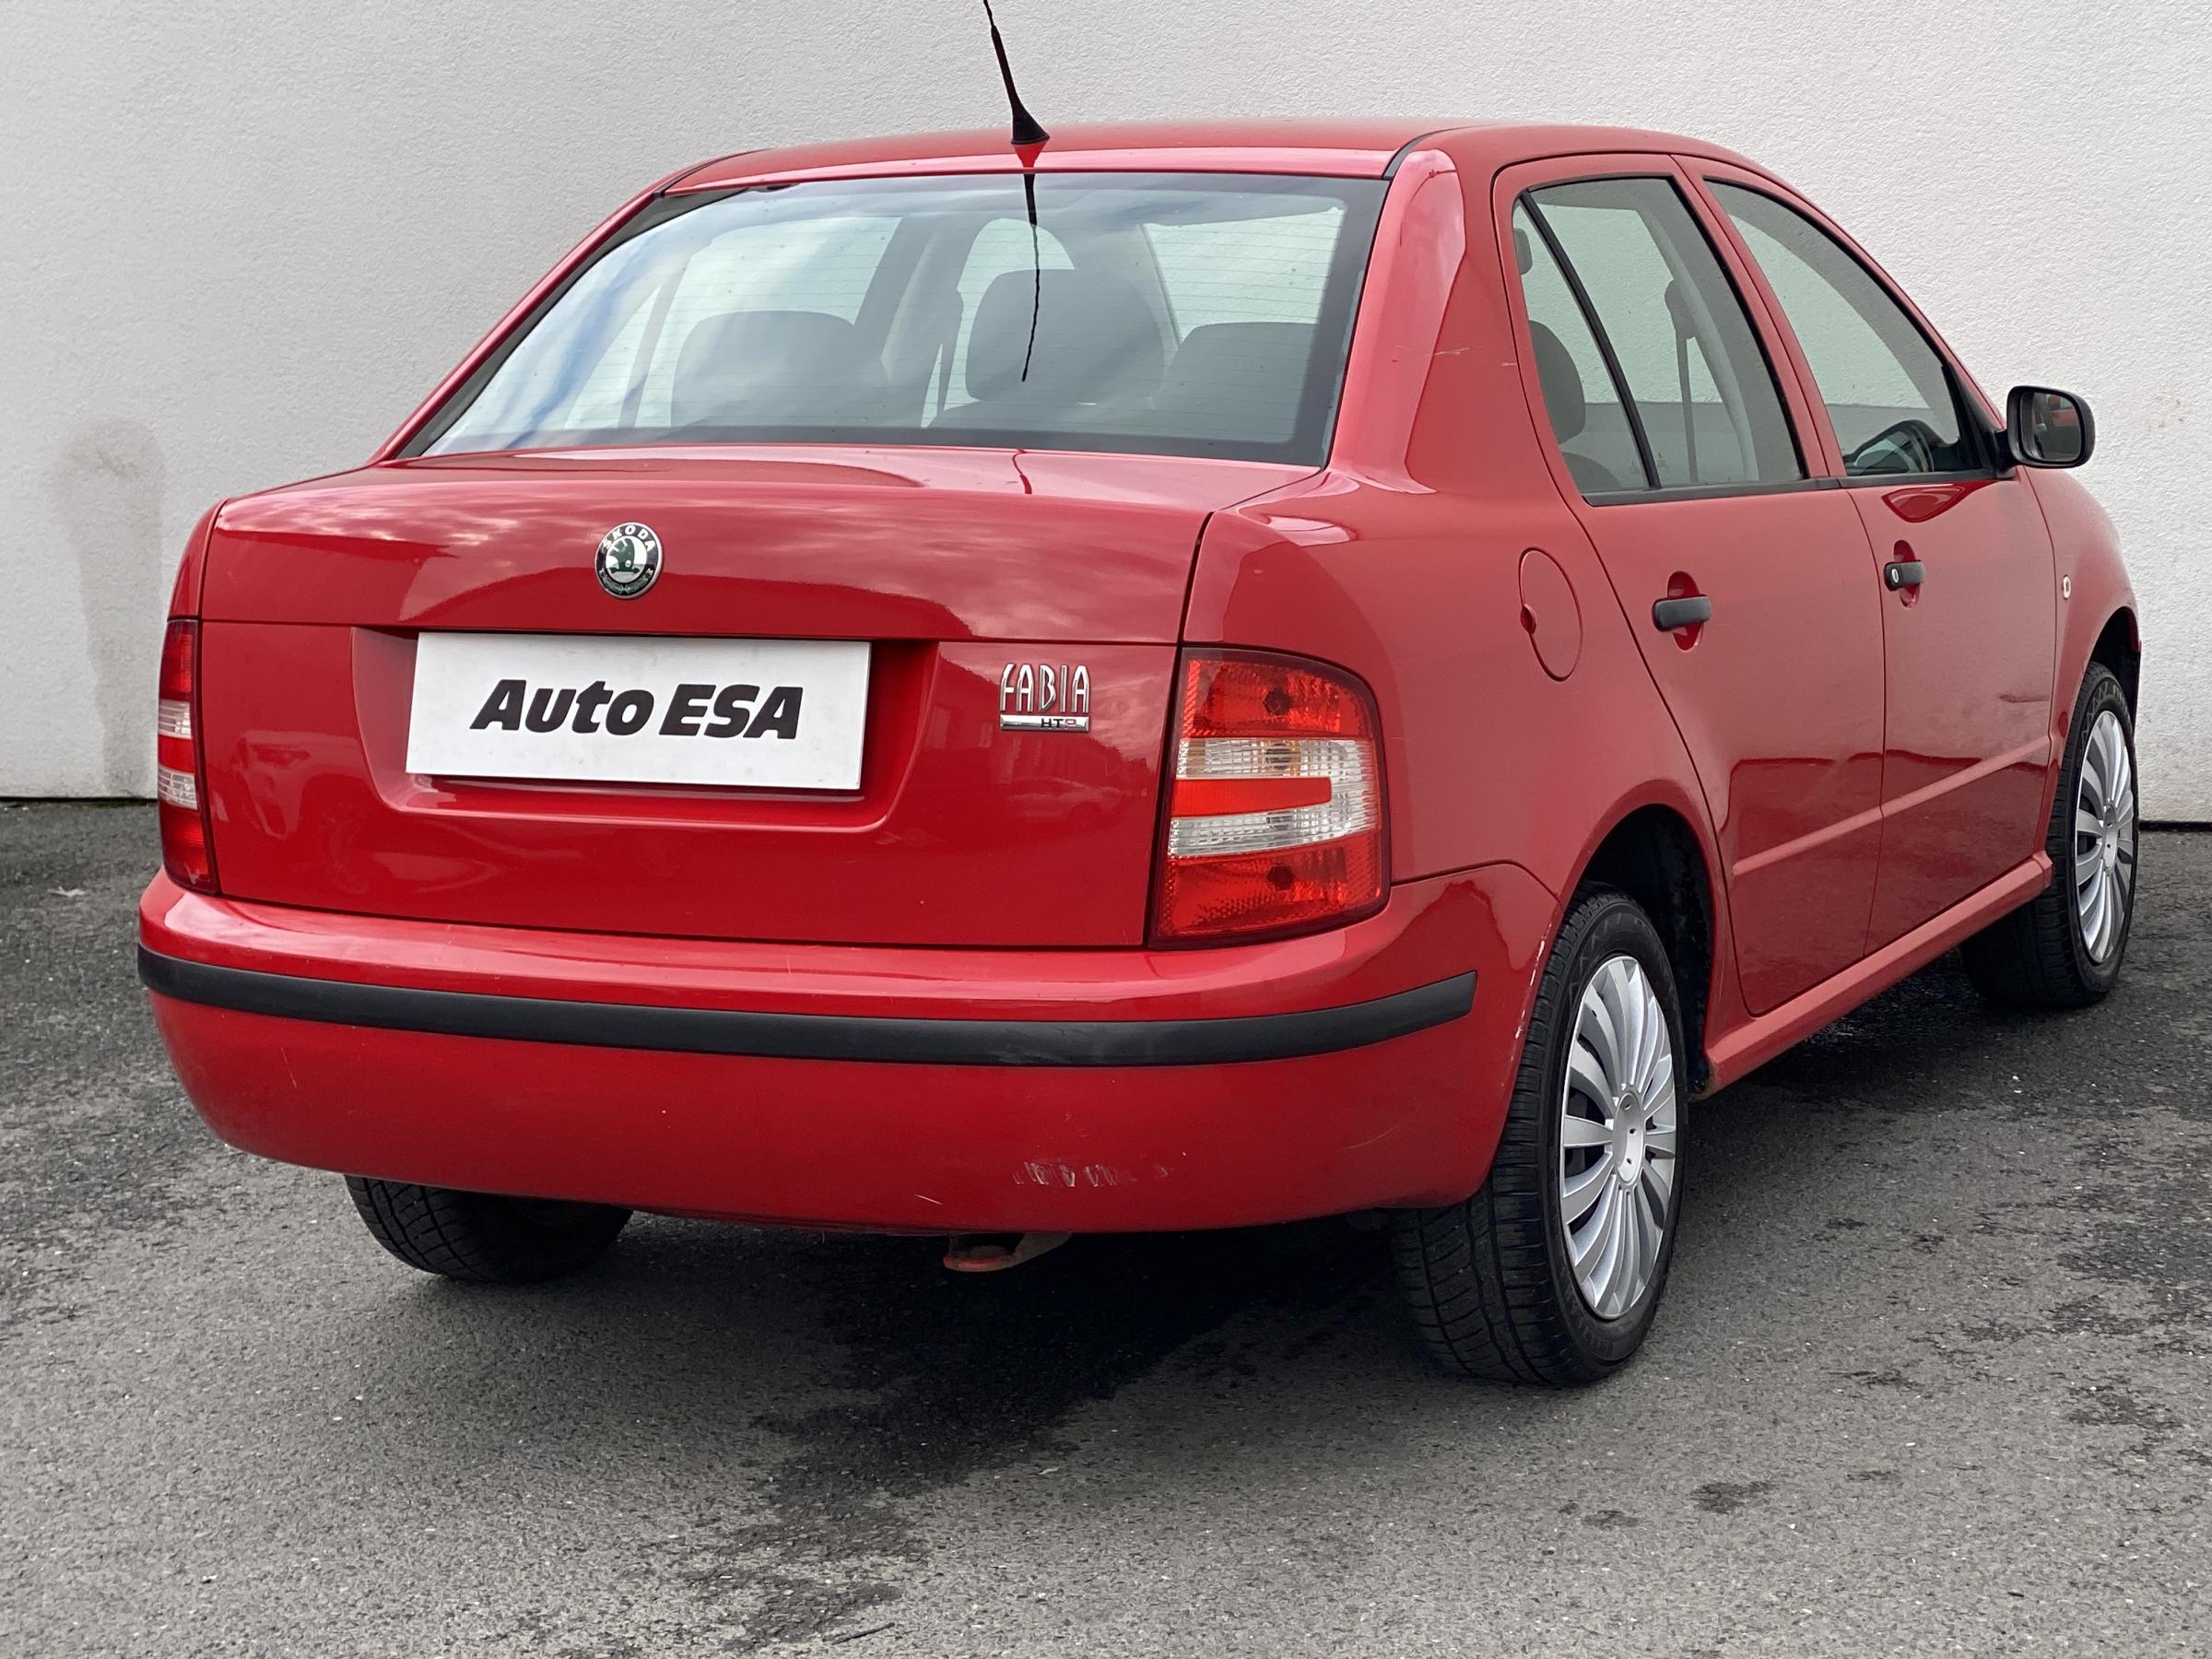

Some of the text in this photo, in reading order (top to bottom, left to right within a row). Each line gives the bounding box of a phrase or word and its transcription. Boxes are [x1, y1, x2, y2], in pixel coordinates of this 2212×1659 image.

[469, 678, 804, 740] Auto ESA
[1000, 663, 1090, 713] FABIA
